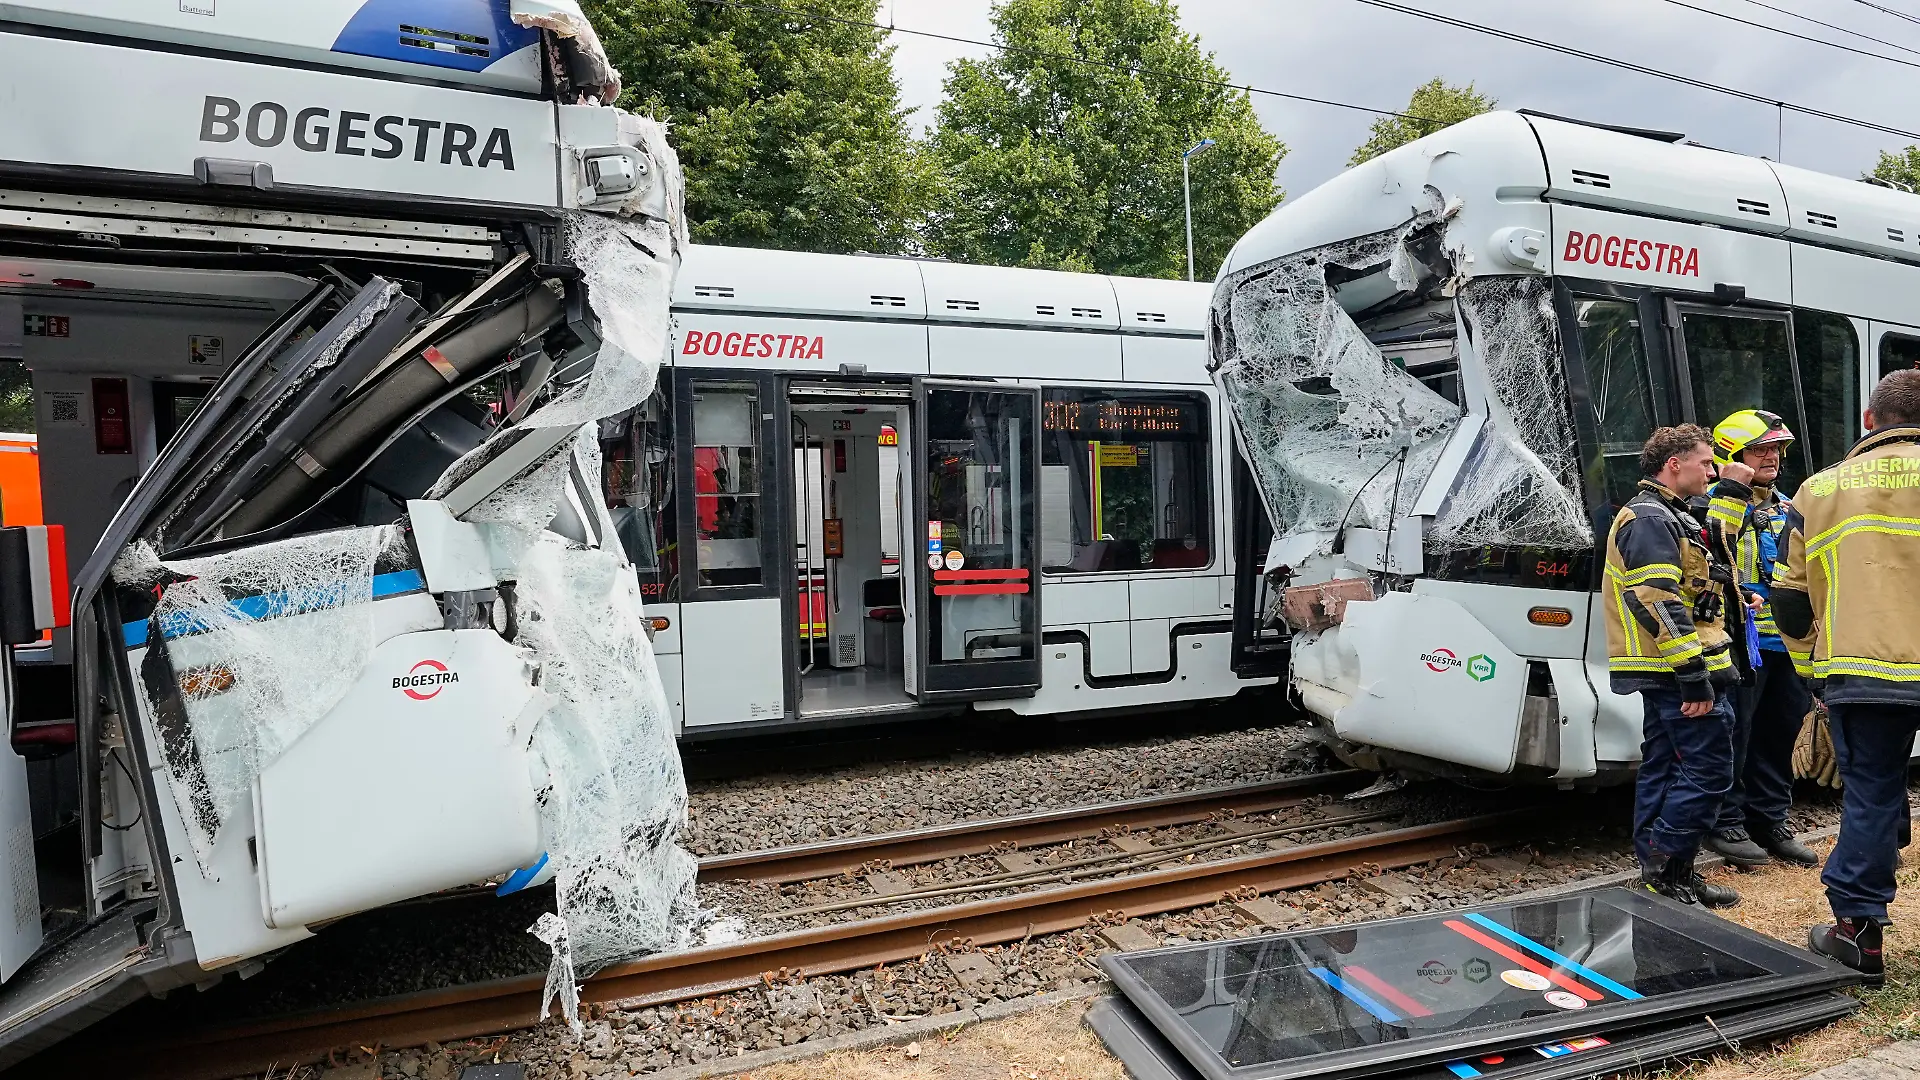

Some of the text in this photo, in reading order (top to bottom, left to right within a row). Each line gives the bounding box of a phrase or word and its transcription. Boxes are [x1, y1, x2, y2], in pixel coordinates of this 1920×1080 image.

[199, 95, 515, 171] BOGESTRA
[1563, 231, 1699, 277] BOGESTRA
[682, 331, 824, 359] BOGESTRA
[1839, 457, 1920, 477] FEUERW
[1839, 473, 1920, 490] GELSENKIR
[1536, 561, 1569, 577] 544
[641, 583, 665, 595] 527
[1420, 653, 1462, 668] BOGESTRA
[1473, 664, 1489, 673] VRR
[392, 672, 459, 688] BOGESTRA
